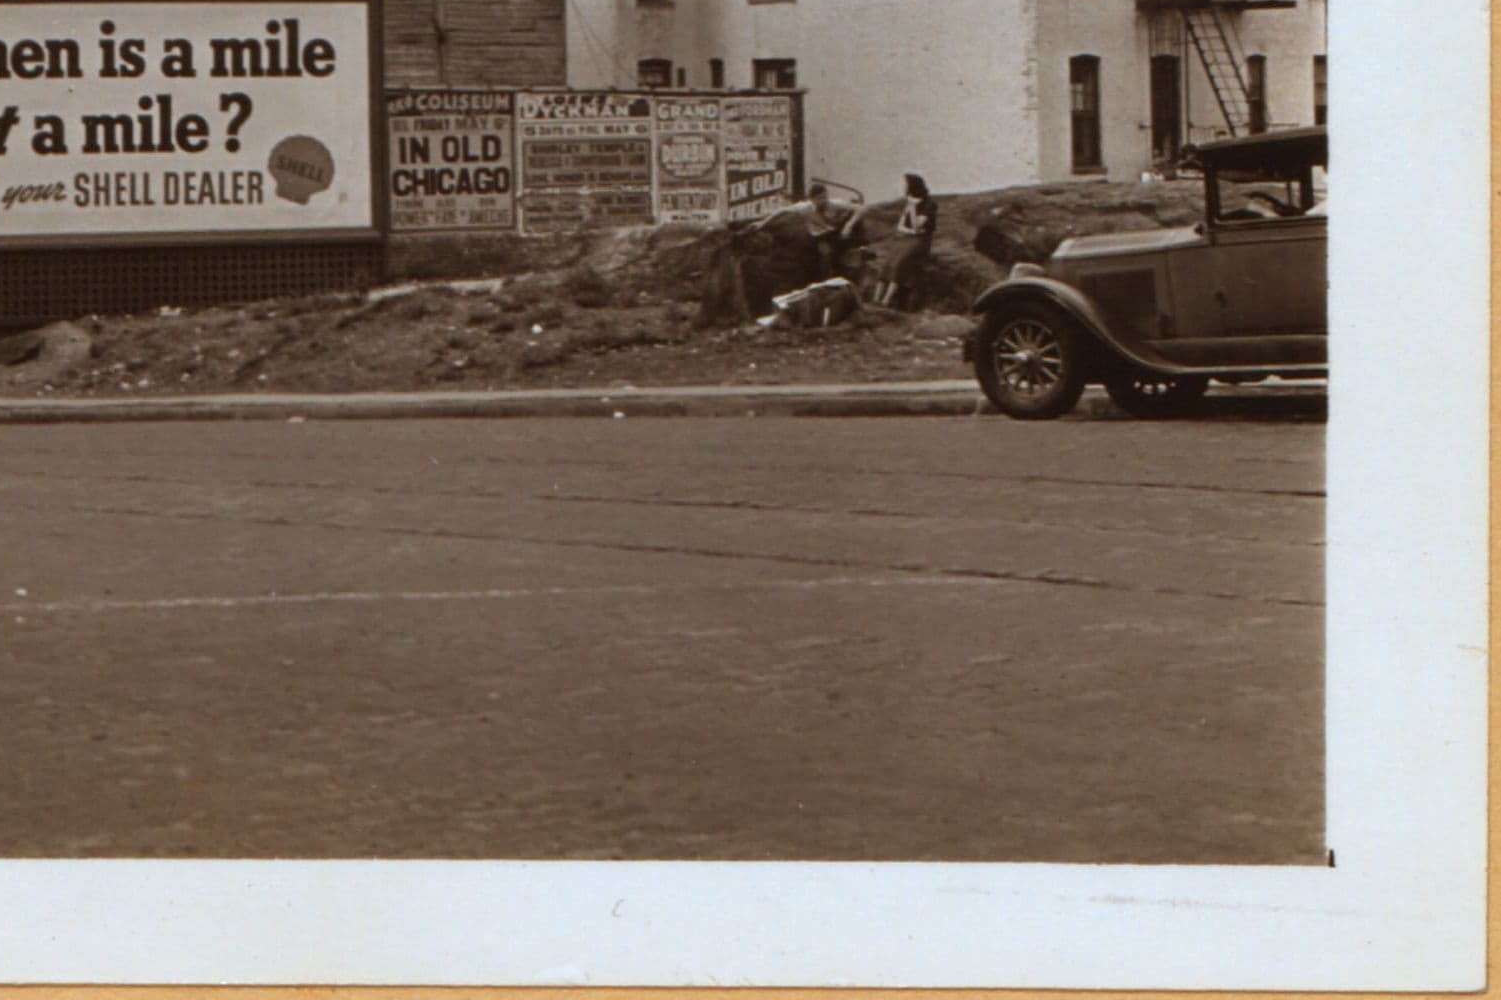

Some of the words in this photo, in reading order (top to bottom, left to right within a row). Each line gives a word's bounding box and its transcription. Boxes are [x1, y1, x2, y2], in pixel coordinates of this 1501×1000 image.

[99, 20, 145, 78] is
[161, 38, 195, 78] a
[210, 18, 336, 77] mile
[415, 93, 510, 111] COLISEUM
[658, 103, 718, 119] GRAND
[31, 115, 68, 154] a
[398, 136, 429, 164] IN
[441, 135, 502, 163] OLD
[276, 155, 324, 183] SHELL
[393, 167, 510, 196] CHICAGO
[2, 181, 67, 210] your
[74, 173, 156, 207] SHELL
[163, 171, 264, 206] DEALER
